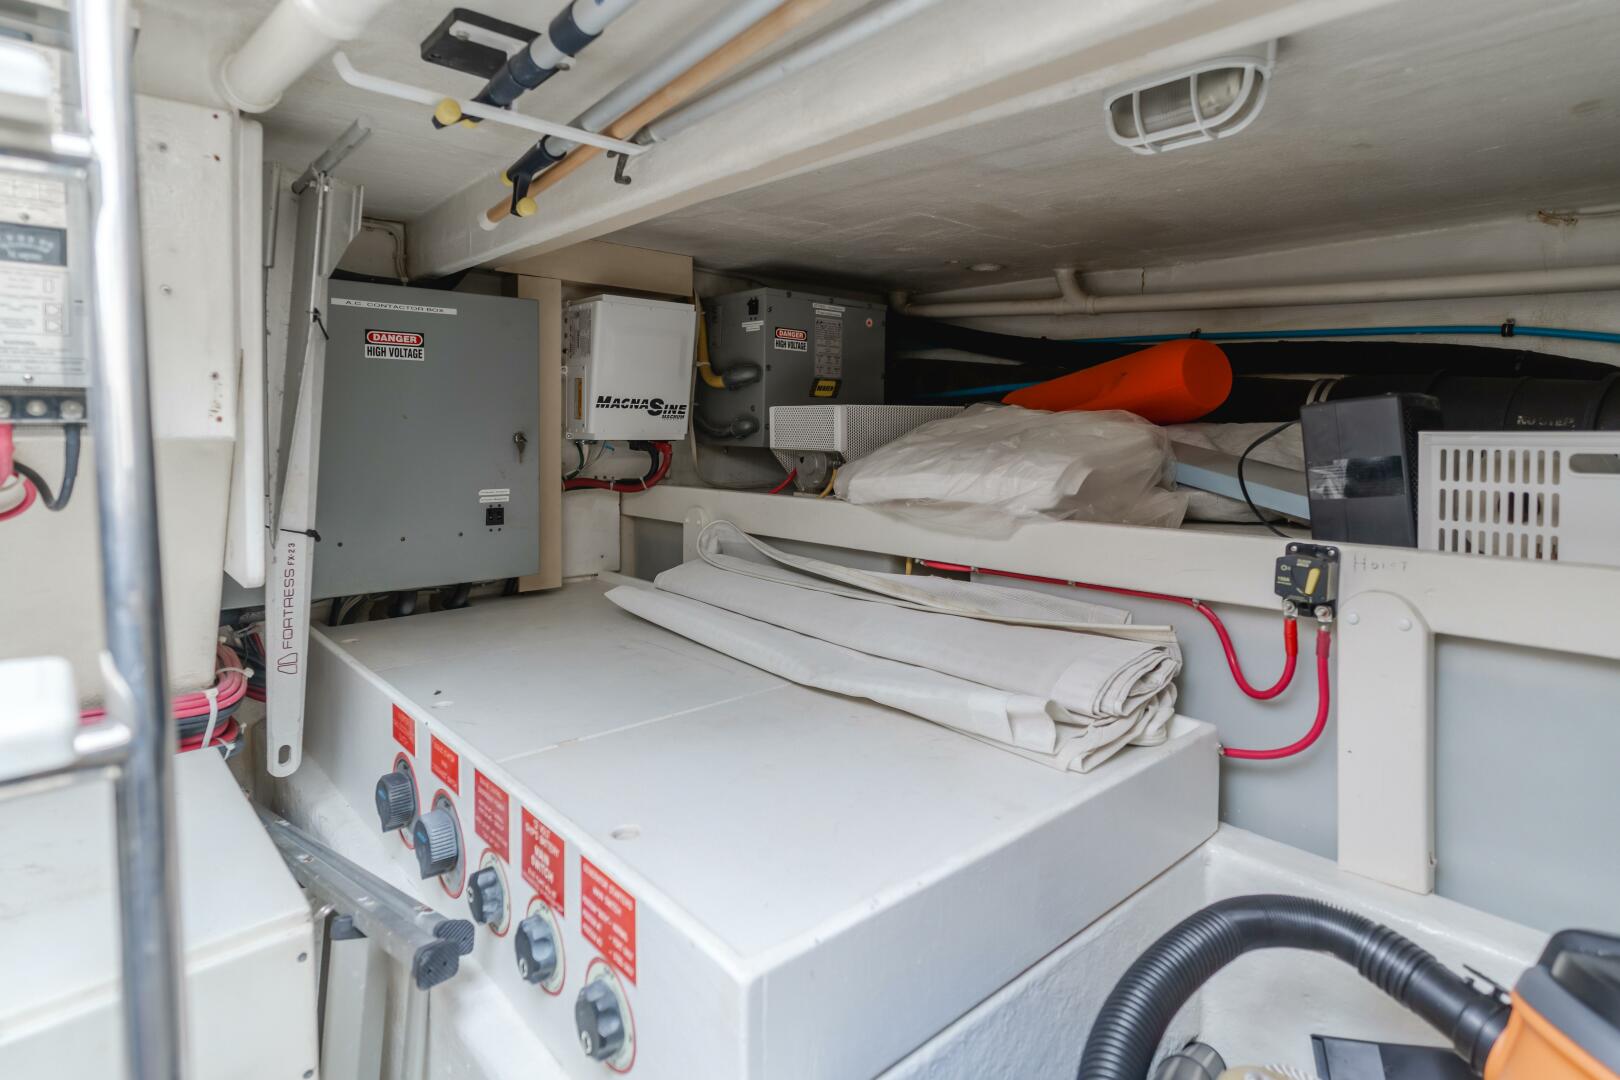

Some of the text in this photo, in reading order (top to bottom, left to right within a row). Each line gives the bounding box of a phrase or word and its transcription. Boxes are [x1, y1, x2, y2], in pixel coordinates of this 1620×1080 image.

[366, 302, 424, 312] CONTACTOR
[372, 333, 418, 344] DANGER
[779, 329, 804, 339] DANGER
[775, 340, 807, 351] HIGH VOLTAGE
[366, 346, 423, 359] HIGH VOLTAGE
[282, 542, 296, 650] FORTRESS FX-23
